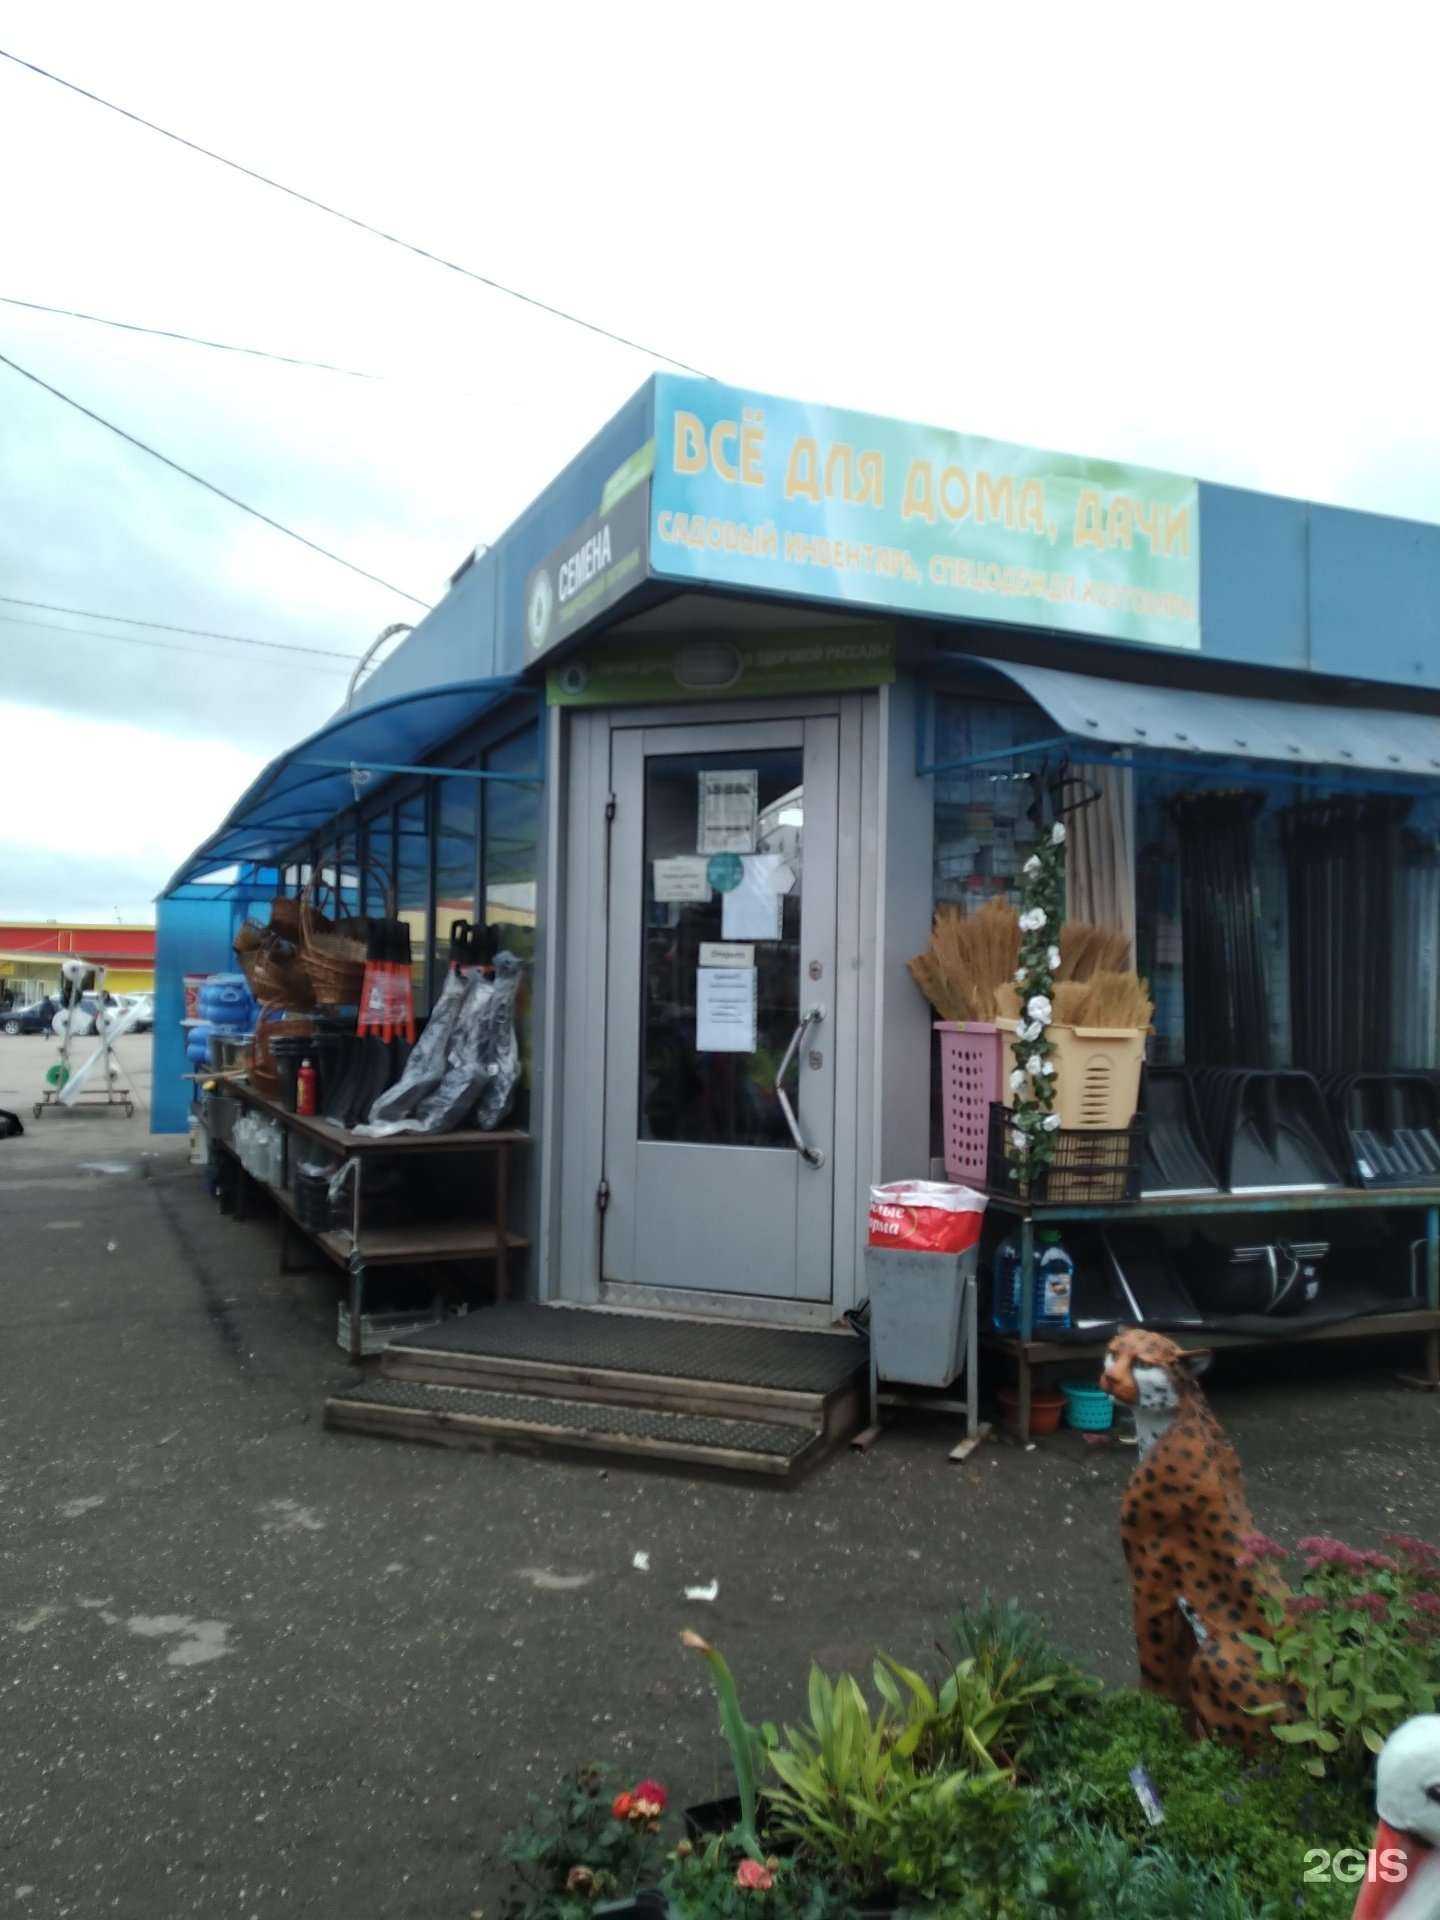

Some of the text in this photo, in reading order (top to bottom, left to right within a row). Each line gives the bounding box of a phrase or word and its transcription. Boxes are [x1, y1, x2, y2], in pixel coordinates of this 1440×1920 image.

[673, 406, 766, 487] ВСЁ
[784, 436, 885, 509] ДЛЯ
[901, 459, 1059, 547] ДОМА,
[1073, 487, 1191, 559] ДАЧИ
[558, 524, 612, 601] СЕМЕНА
[657, 511, 778, 560] САДОВЫЙ
